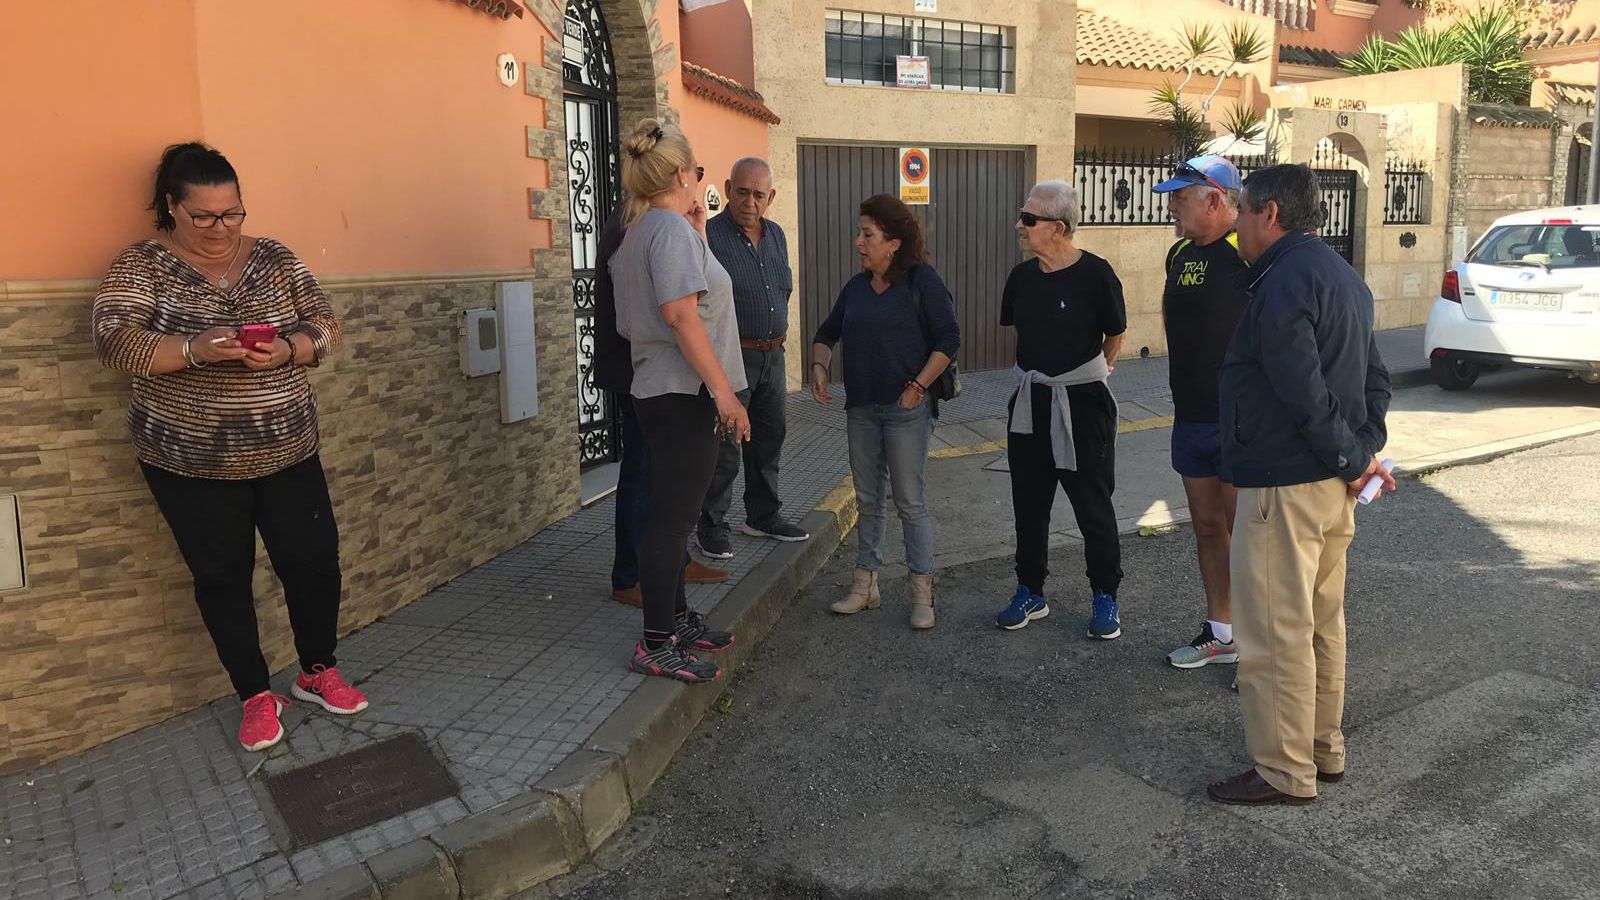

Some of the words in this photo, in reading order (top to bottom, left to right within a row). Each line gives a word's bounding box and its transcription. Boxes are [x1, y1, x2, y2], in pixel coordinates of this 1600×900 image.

[504, 61, 515, 80] 11
[1313, 96, 1332, 108] MARI
[1338, 98, 1367, 111] CARMEN
[1340, 115, 1349, 127] 13
[1182, 260, 1208, 273] TRAI
[1177, 272, 1205, 286] NING
[1499, 293, 1528, 305] 0354
[1534, 294, 1558, 306] JCG
